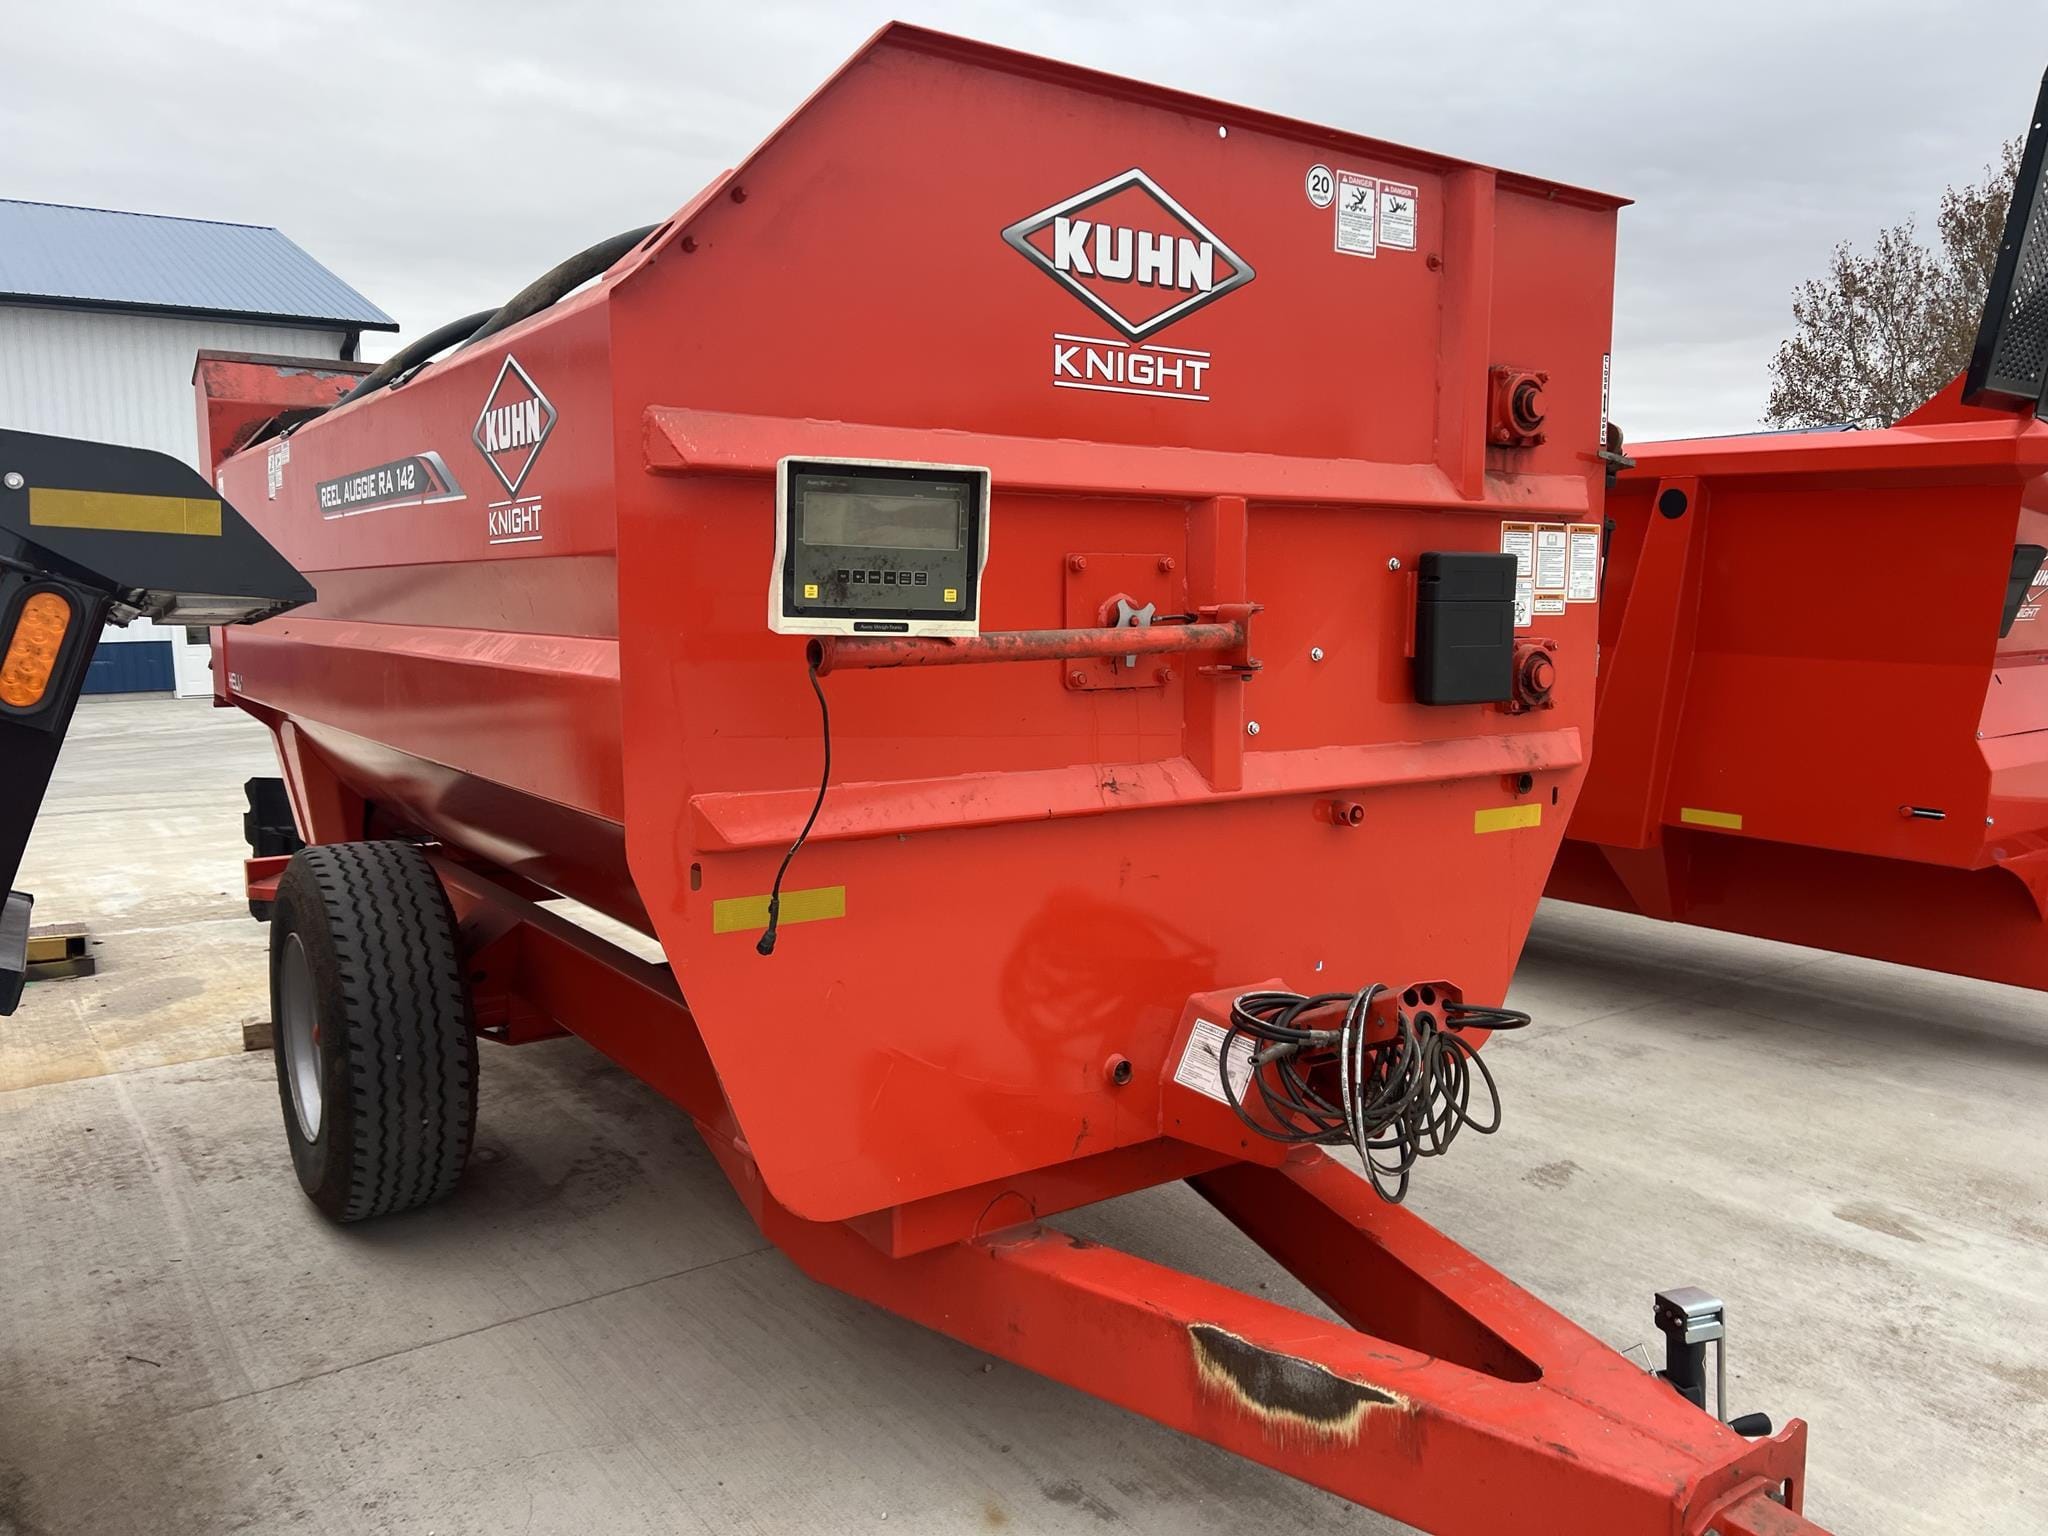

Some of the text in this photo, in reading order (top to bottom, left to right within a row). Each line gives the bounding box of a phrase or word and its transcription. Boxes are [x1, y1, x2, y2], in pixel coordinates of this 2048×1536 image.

[1312, 174, 1330, 194] 20
[1348, 176, 1373, 188] DANGER
[1390, 185, 1412, 197] DANGER
[1054, 215, 1214, 292] KUHN
[1054, 343, 1210, 391] KNIGHT
[485, 397, 541, 453] KUHN
[321, 464, 415, 508] REEL AUGGIE RA 142
[489, 504, 542, 537] KNIGHT
